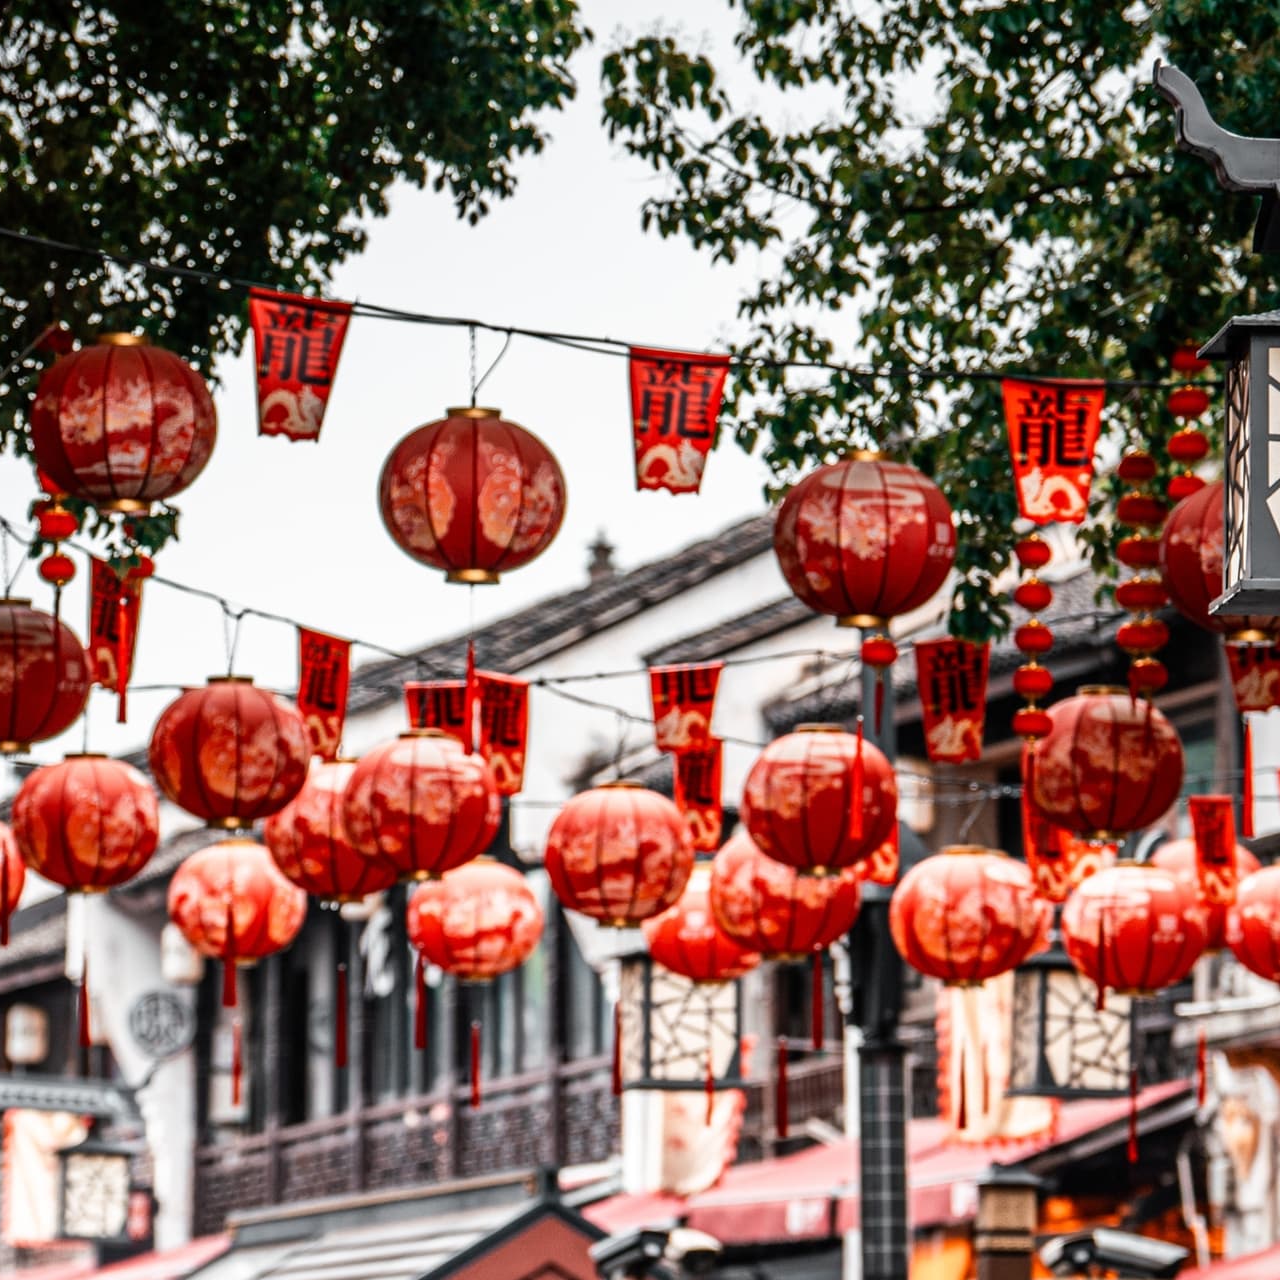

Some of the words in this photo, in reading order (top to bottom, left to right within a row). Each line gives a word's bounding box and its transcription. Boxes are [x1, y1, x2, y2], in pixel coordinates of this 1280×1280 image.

[262, 302, 335, 387] 龍
[640, 358, 713, 439] 龍
[1017, 389, 1090, 467] 龍
[929, 641, 983, 717] 龍
